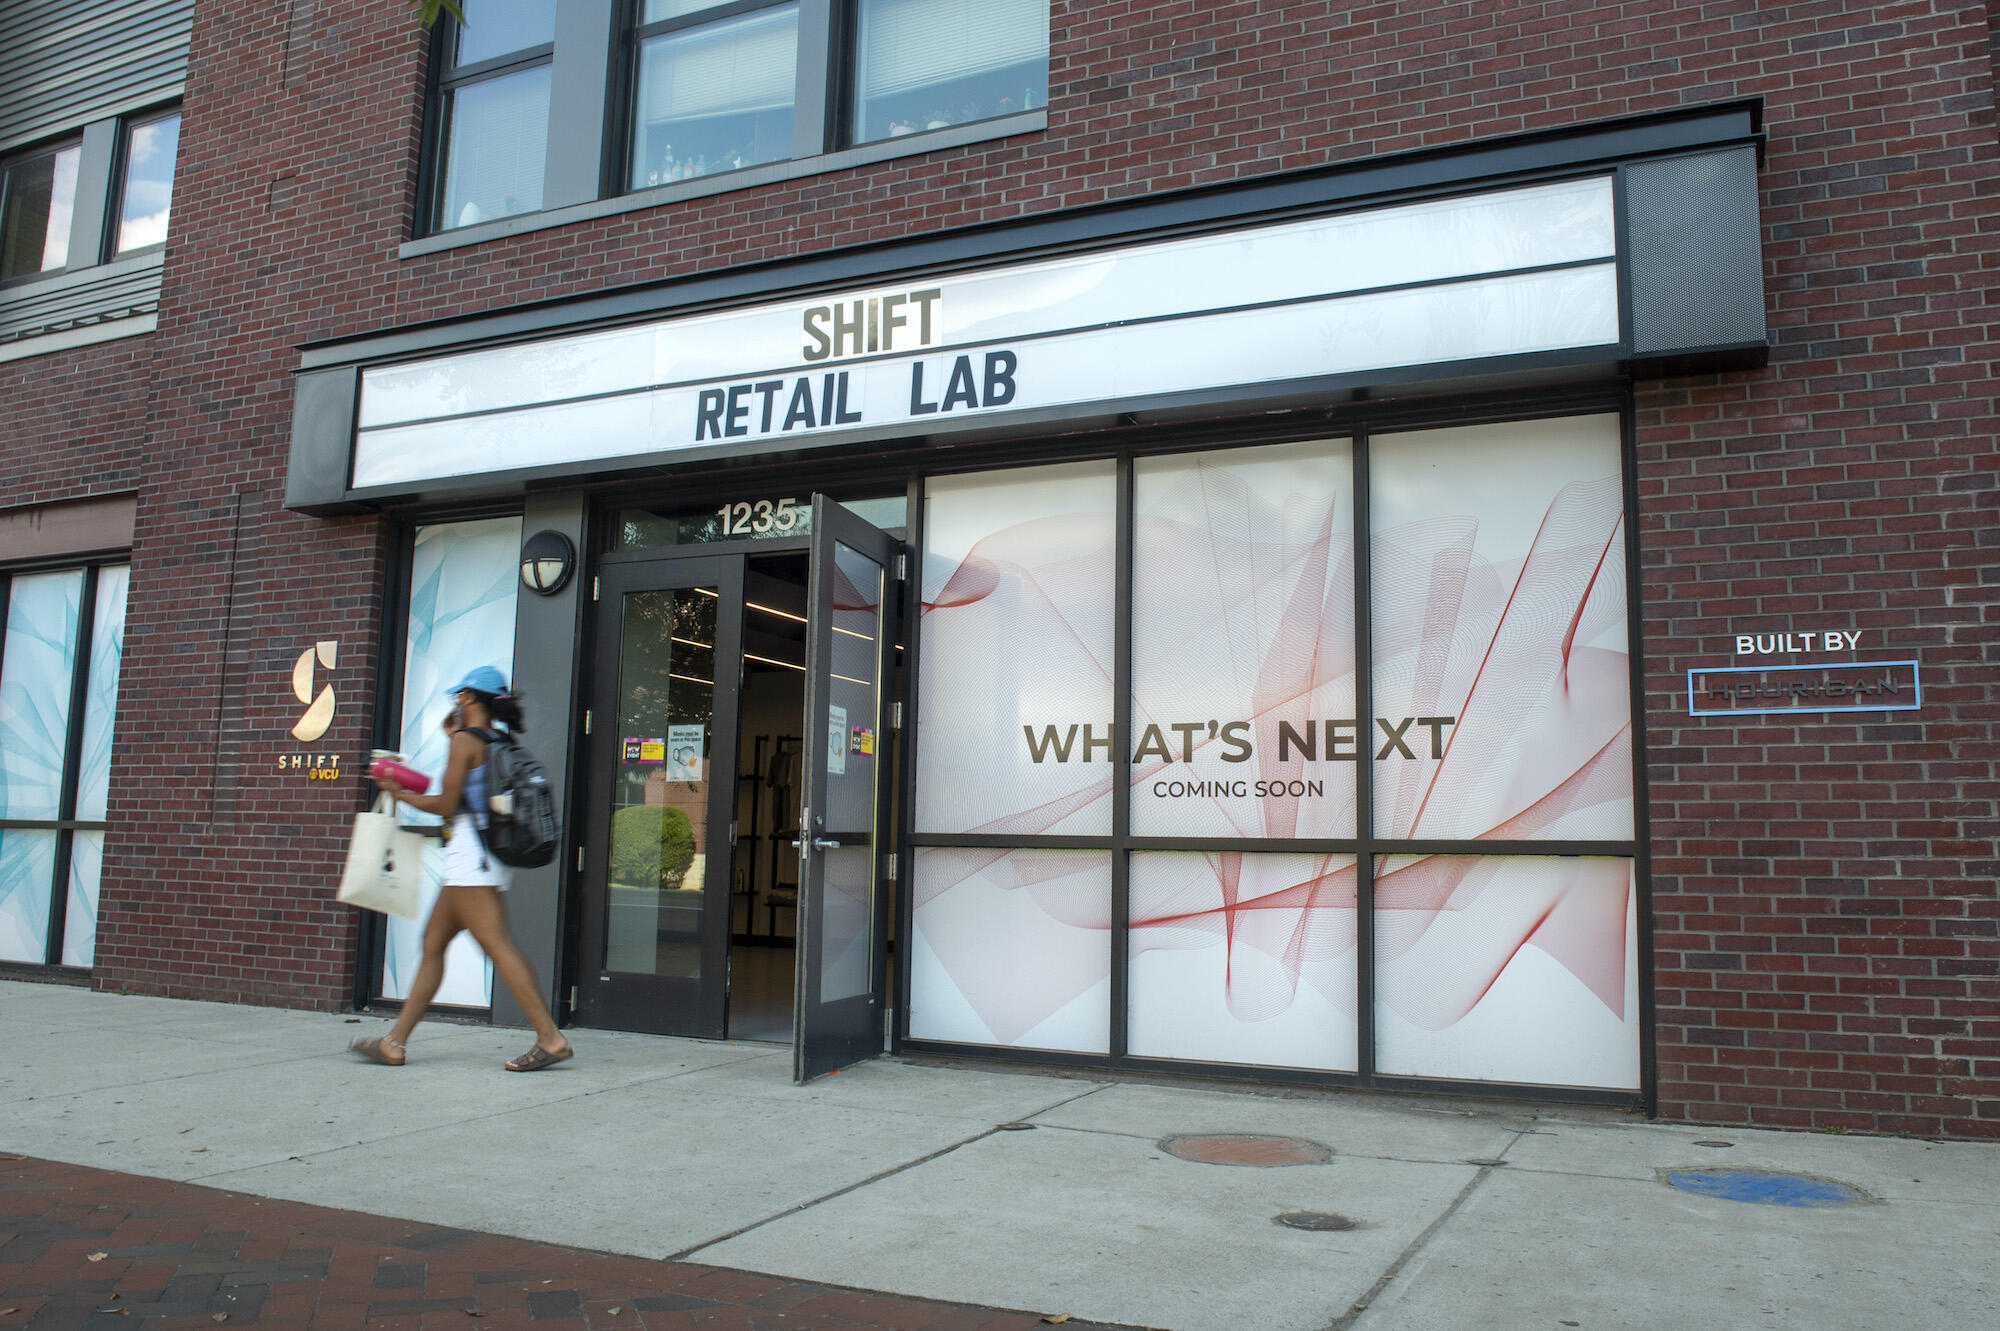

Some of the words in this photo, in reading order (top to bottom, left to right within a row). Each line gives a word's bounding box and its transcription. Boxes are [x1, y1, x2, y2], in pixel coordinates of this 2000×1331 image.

[803, 288, 941, 362] SHIFT
[696, 371, 862, 441] RETAIL
[910, 350, 1017, 416] LAB
[717, 498, 797, 535] 1235
[1735, 633, 1816, 655] BUILT
[1824, 630, 1863, 651] BY
[1707, 677, 1899, 699] HOURIGAN
[1278, 715, 1456, 762] NEXT
[278, 754, 340, 769] SHIFT
[1153, 780, 1248, 799] COMING
[1254, 780, 1324, 798] SOON
